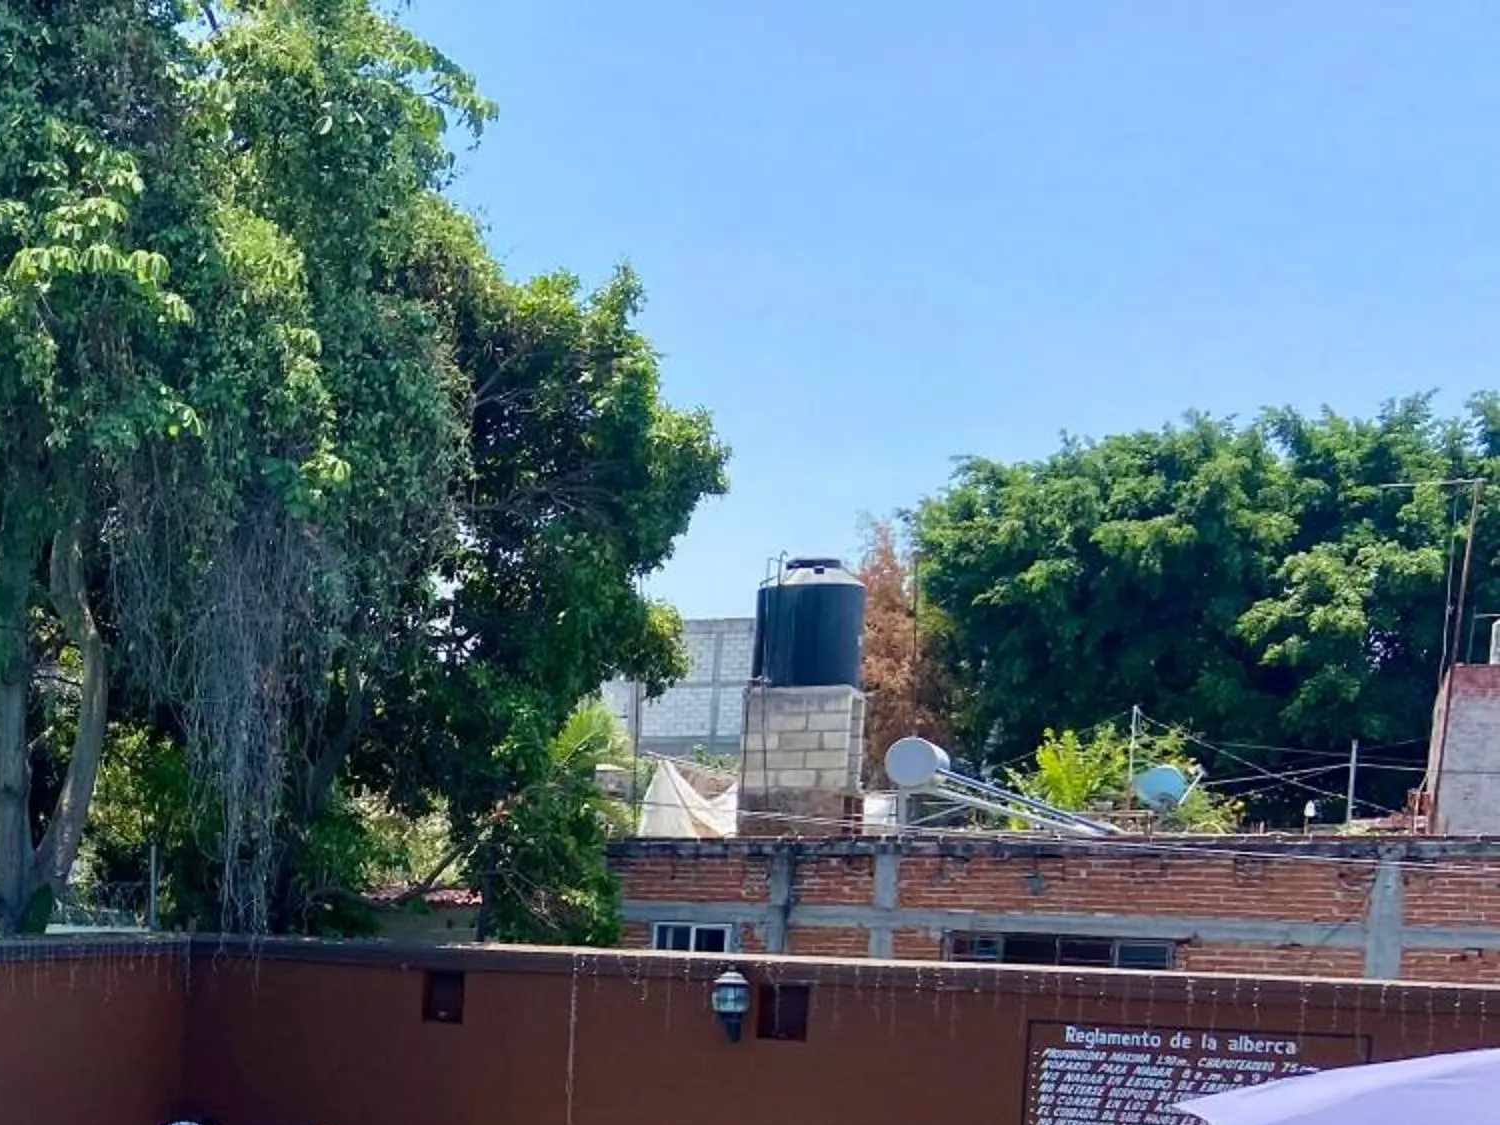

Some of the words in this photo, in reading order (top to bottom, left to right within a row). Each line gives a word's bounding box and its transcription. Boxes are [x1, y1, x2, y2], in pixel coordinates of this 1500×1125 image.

[1065, 1025, 1161, 1049] Reglamento
[1169, 1031, 1193, 1049] de
[1201, 1033, 1218, 1050] la
[1228, 1034, 1297, 1055] alberca
[1039, 1071, 1060, 1082] NO
[1177, 1079, 1196, 1091] DE
[1098, 1063, 1129, 1074] PARA
[1132, 1066, 1174, 1078] NADAR
[1234, 1073, 1243, 1083] a
[1035, 1105, 1050, 1116] EL
[1037, 1093, 1054, 1105] NO
[1055, 1095, 1101, 1108] CORRER
[1104, 1098, 1122, 1110] EN
[1124, 1099, 1150, 1111] LOS
